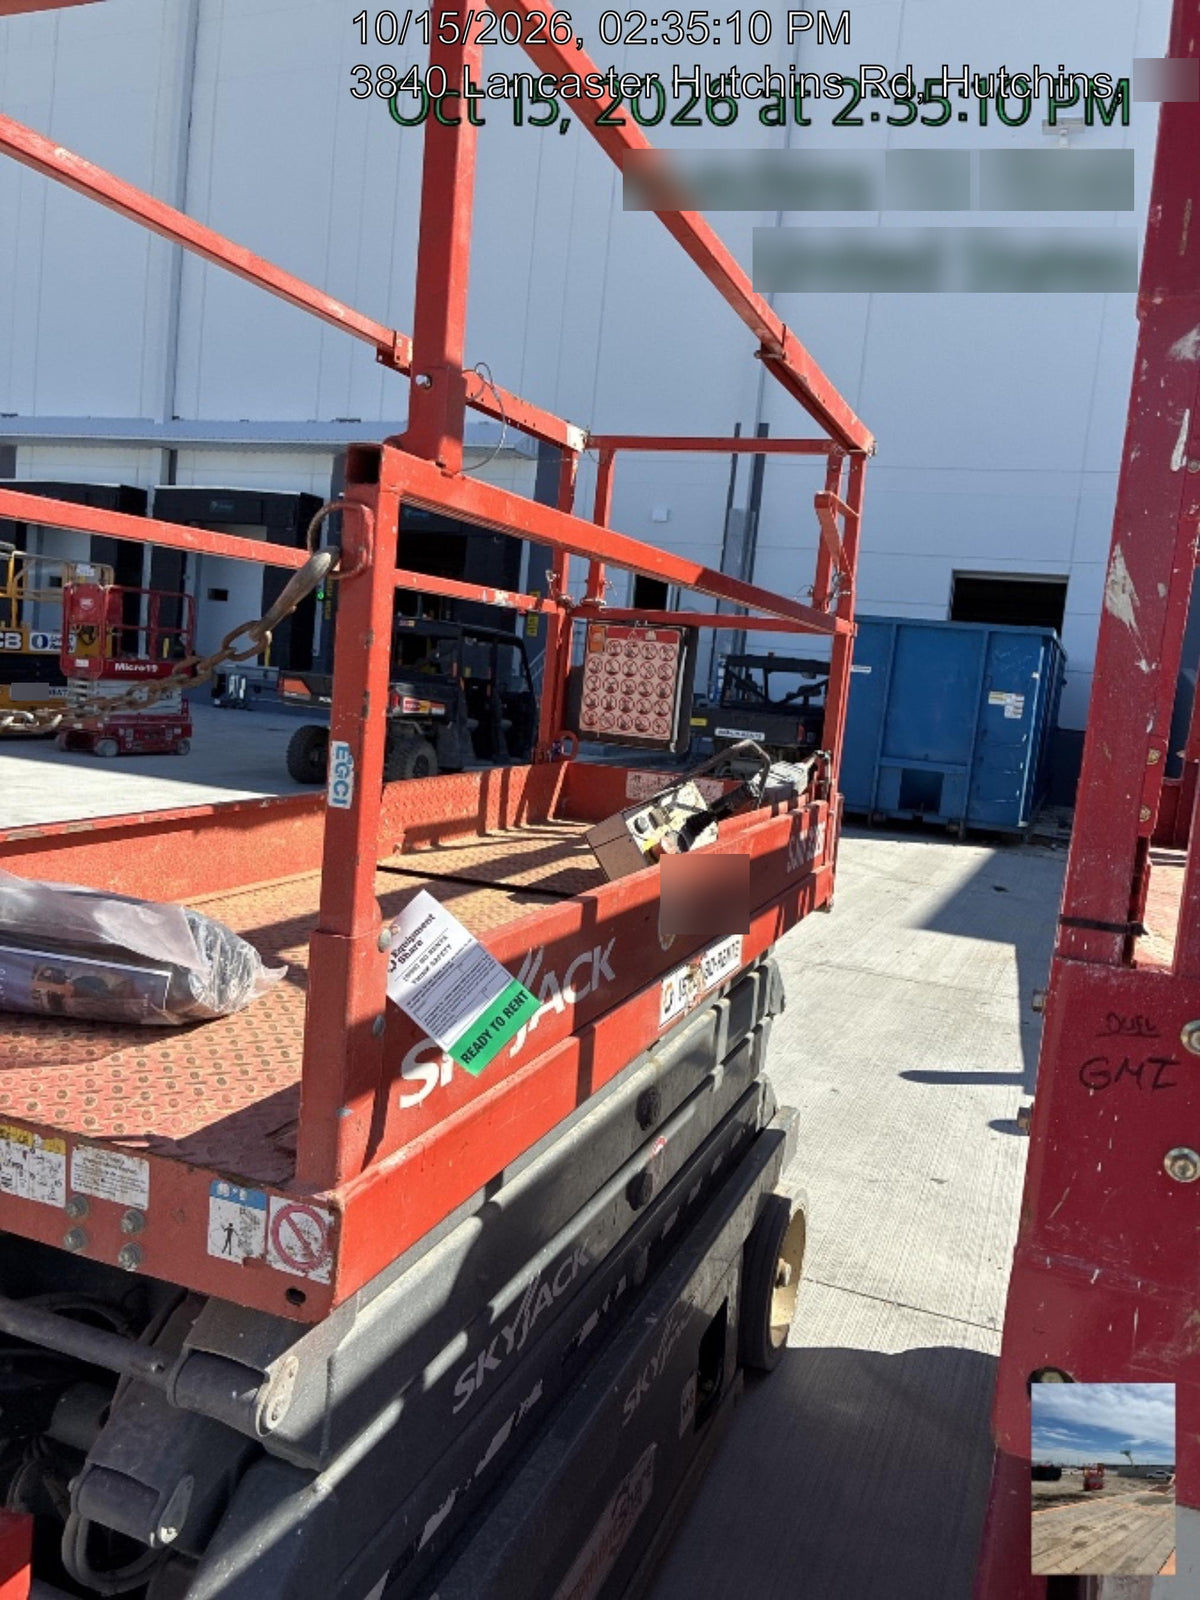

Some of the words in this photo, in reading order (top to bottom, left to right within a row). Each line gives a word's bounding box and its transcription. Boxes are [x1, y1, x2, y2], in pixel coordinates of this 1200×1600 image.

[333, 745, 350, 806] EGCI
[392, 913, 436, 959] Equipment
[398, 939, 424, 965] Share
[400, 937, 617, 1109] SJACK
[460, 1029, 493, 1065] READY
[490, 1015, 506, 1033] TO
[504, 990, 529, 1019] RENT
[452, 1239, 590, 1415] SKYJACK
